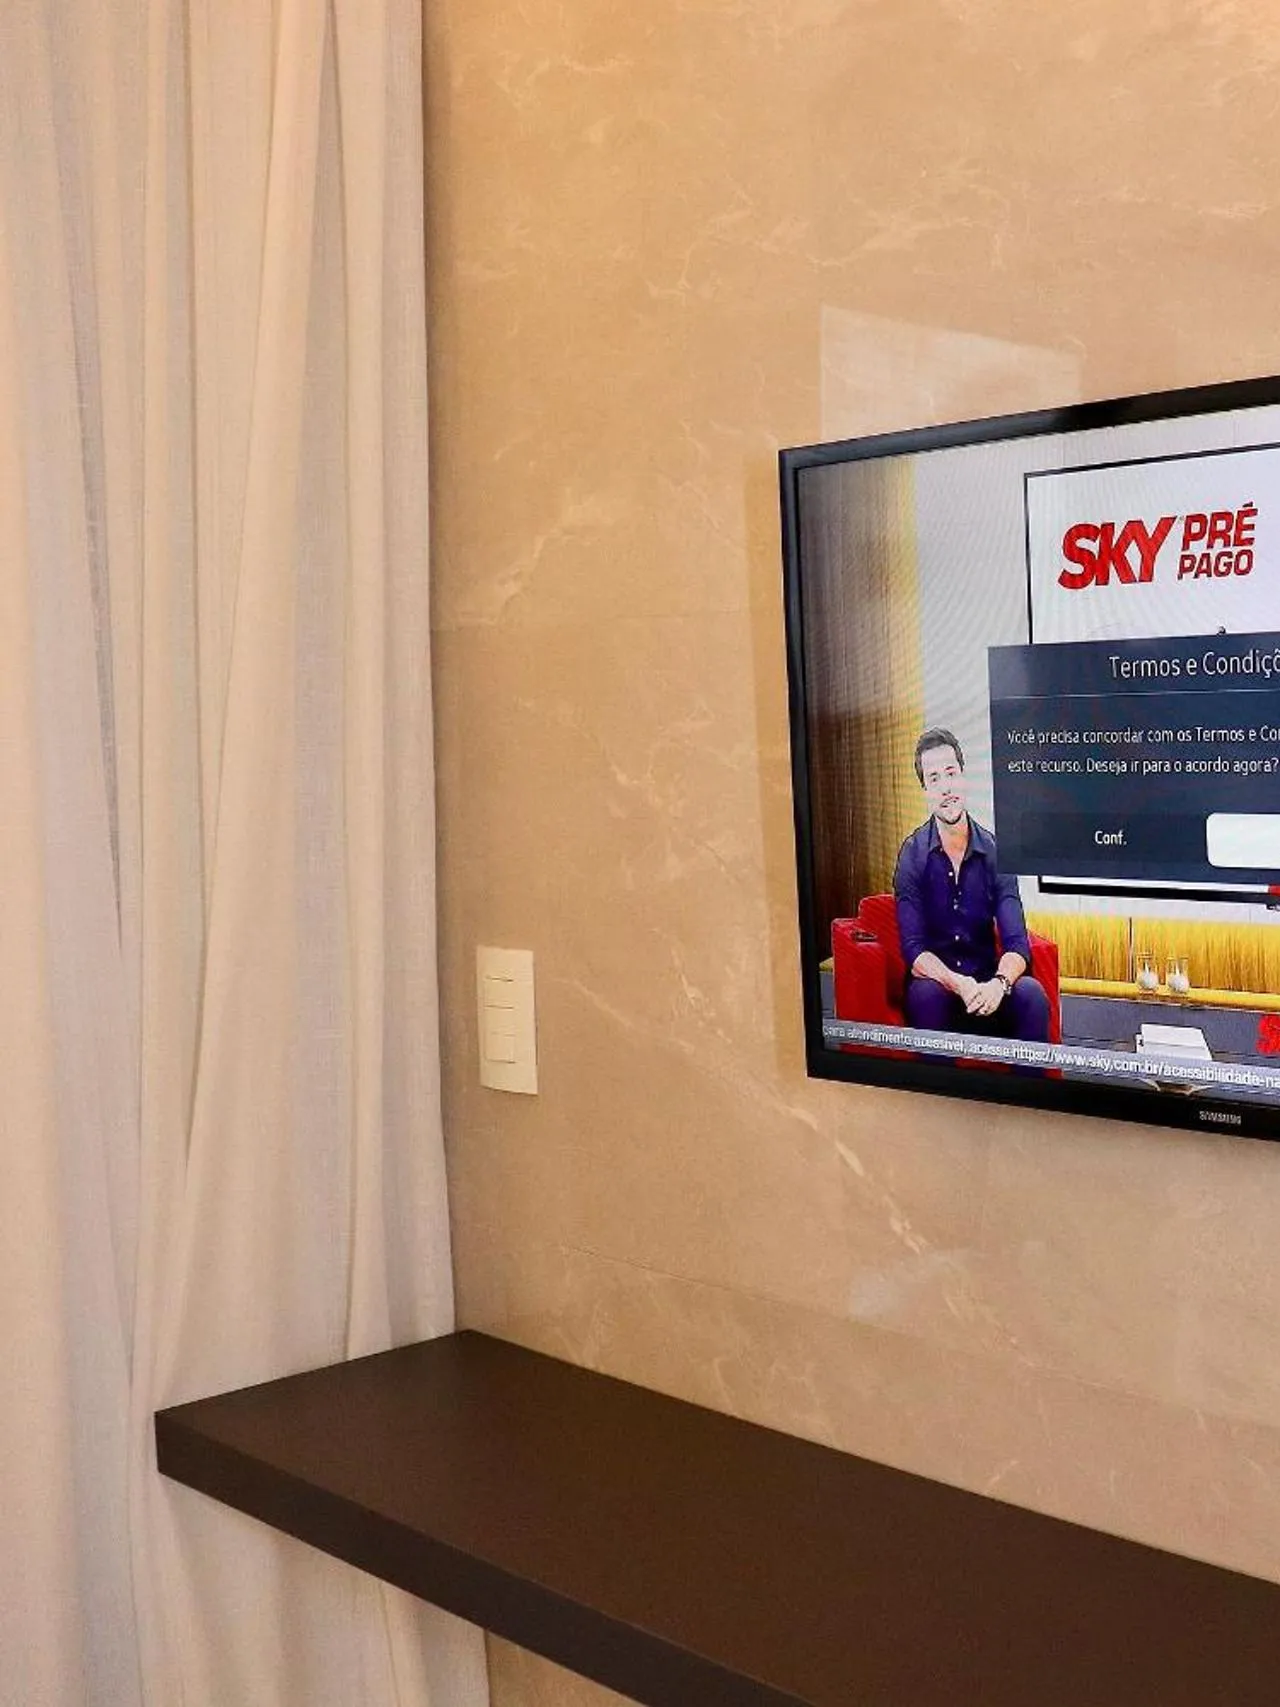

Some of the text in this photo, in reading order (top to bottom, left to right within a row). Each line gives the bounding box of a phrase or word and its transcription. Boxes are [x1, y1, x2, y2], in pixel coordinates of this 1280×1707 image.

[1181, 501, 1258, 551] PRÉ
[1057, 515, 1177, 590] SKY
[1177, 549, 1254, 580] PAGO
[1109, 656, 1180, 679] Termos
[1186, 657, 1198, 676] e
[1007, 728, 1035, 744] Você
[1038, 728, 1080, 747] precisa
[1082, 726, 1144, 744] concordar
[1147, 729, 1174, 743] com
[1177, 729, 1192, 742] os
[1194, 726, 1245, 742] Termos
[1248, 729, 1257, 742] e
[1008, 756, 1279, 776] este recurso. Deseja ir para o acordo agora?
[1094, 830, 1128, 846] Conf.
